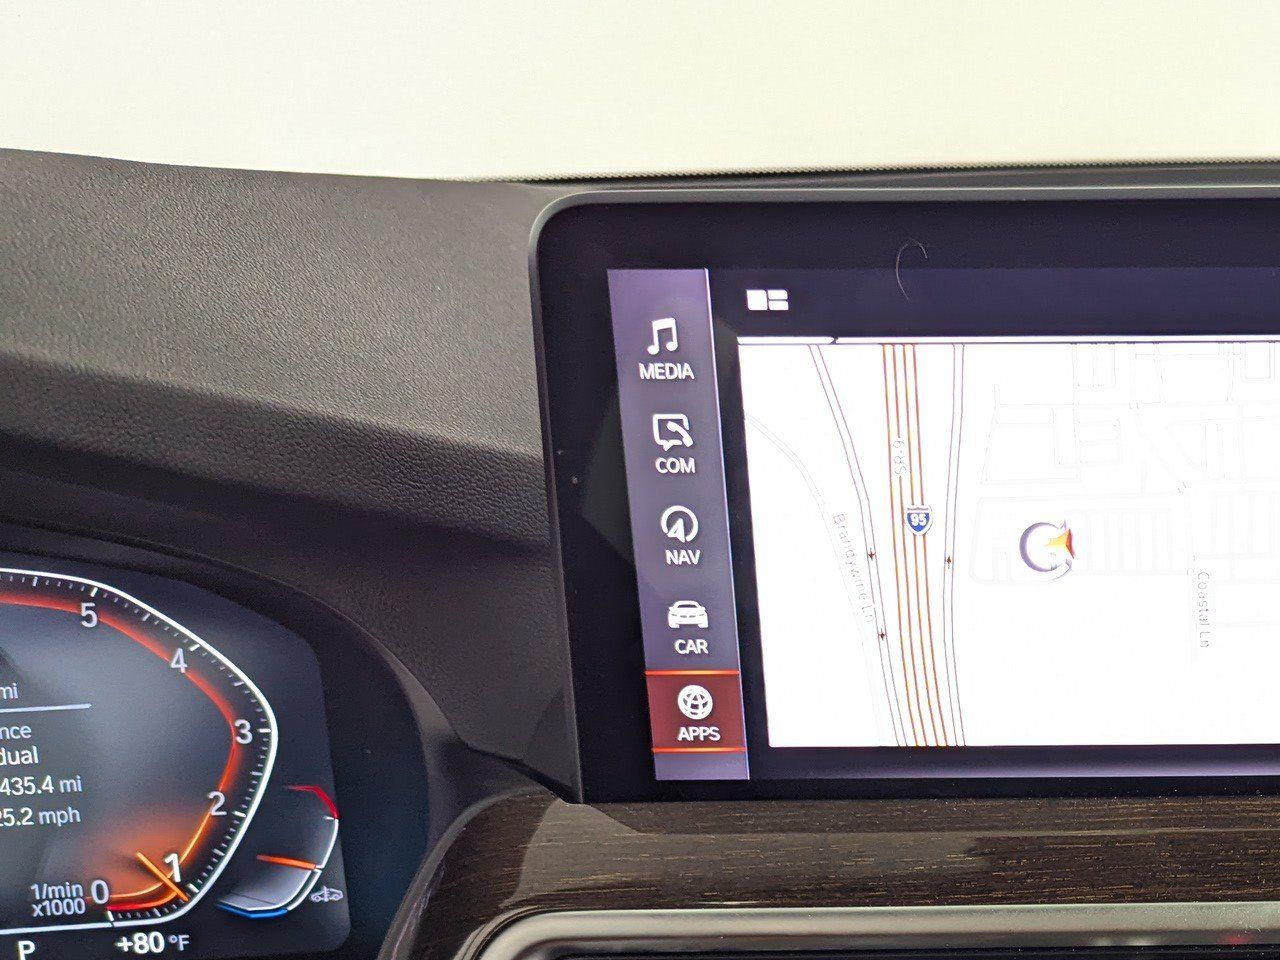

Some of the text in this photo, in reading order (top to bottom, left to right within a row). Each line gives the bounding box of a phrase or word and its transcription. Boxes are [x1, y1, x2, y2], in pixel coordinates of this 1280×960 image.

[639, 363, 694, 380] MEDIA
[655, 457, 695, 474] COM
[910, 513, 927, 527] 95
[665, 549, 700, 566] NAV
[80, 603, 99, 627] 5
[675, 639, 708, 655] CAR
[171, 648, 187, 673] 4
[235, 720, 253, 744] 3
[677, 726, 720, 742] APPS
[60, 775, 82, 793] mi
[208, 792, 227, 816] 2
[39, 806, 81, 827] mph
[165, 853, 181, 883] 1
[31, 882, 83, 900] 1/min
[91, 880, 109, 904] 0
[31, 899, 86, 917] x1000
[116, 932, 164, 954] +80
